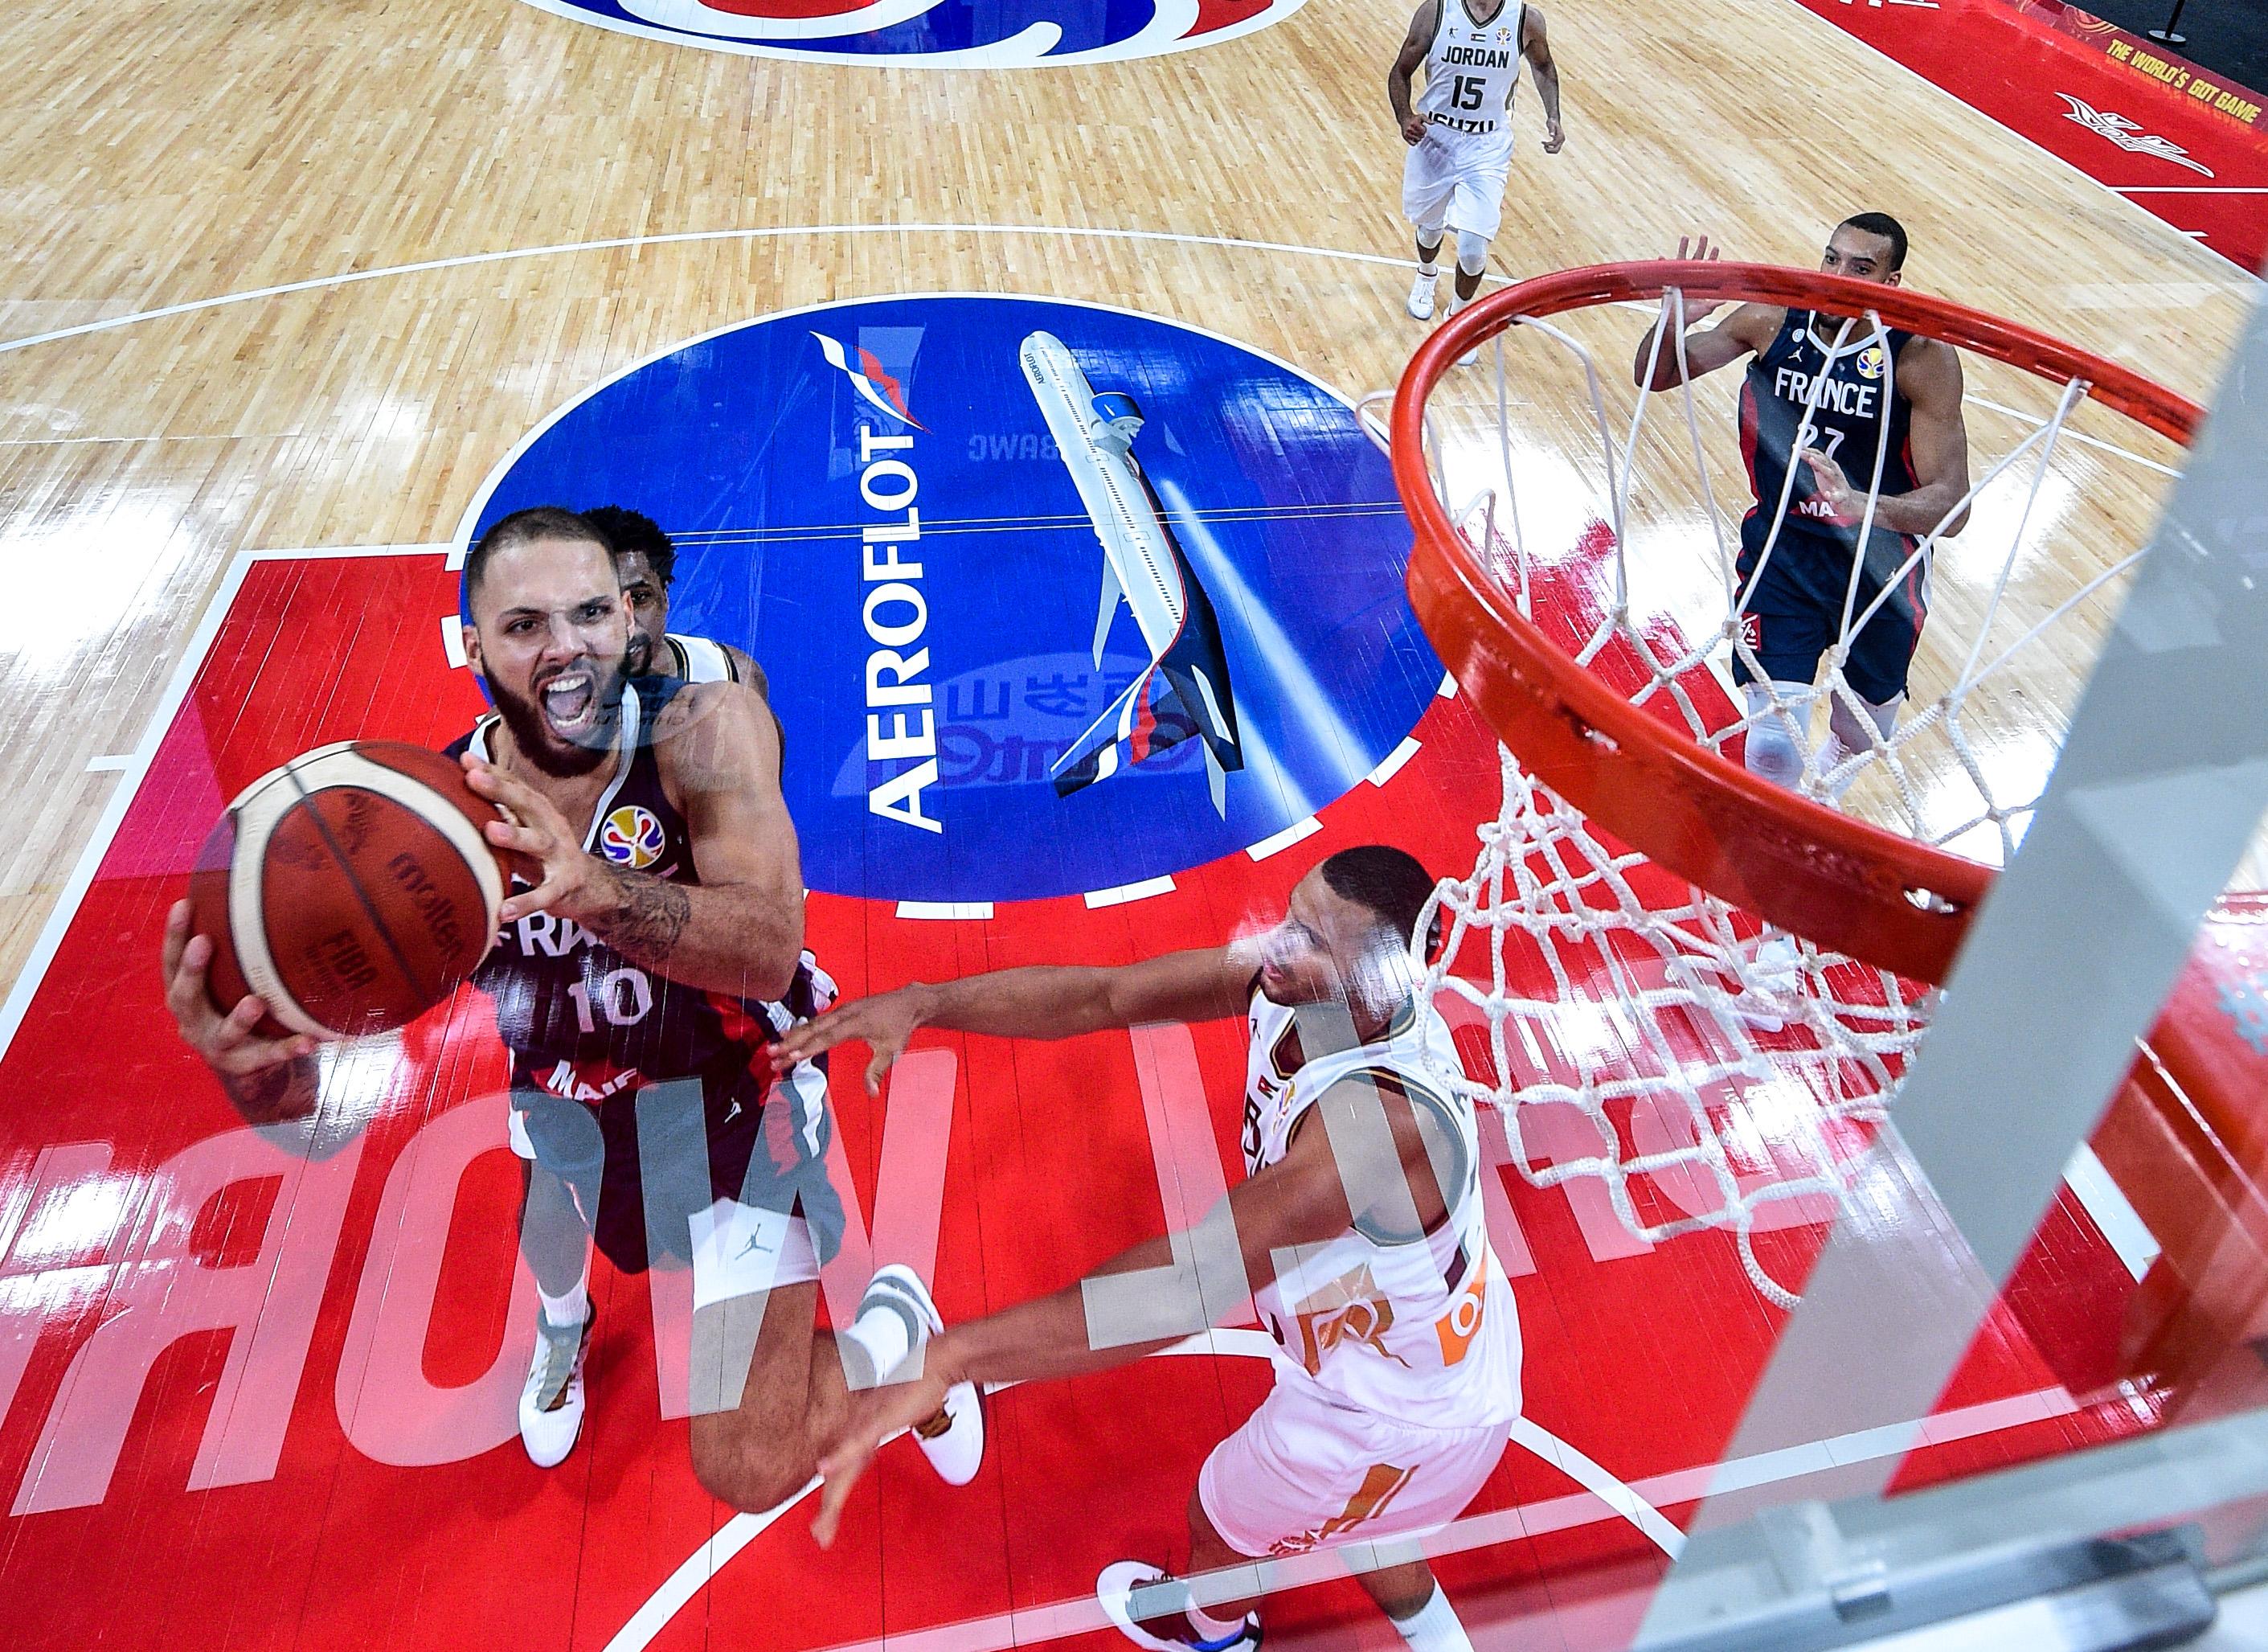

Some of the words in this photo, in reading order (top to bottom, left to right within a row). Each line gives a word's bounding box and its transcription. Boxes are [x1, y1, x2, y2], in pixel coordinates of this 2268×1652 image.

[1441, 46, 1509, 68] JORDAN
[2106, 39, 2134, 61] THE
[2130, 50, 2191, 89] WORLD'S
[2188, 78, 2221, 102] GOT
[2214, 92, 2262, 124] GAME
[1451, 76, 1486, 110] 15
[1023, 352, 1046, 384] AEROFLOT
[1775, 367, 1877, 419] FRANCE
[860, 425, 944, 834] AEROFLOT
[567, 967, 653, 1033] 10
